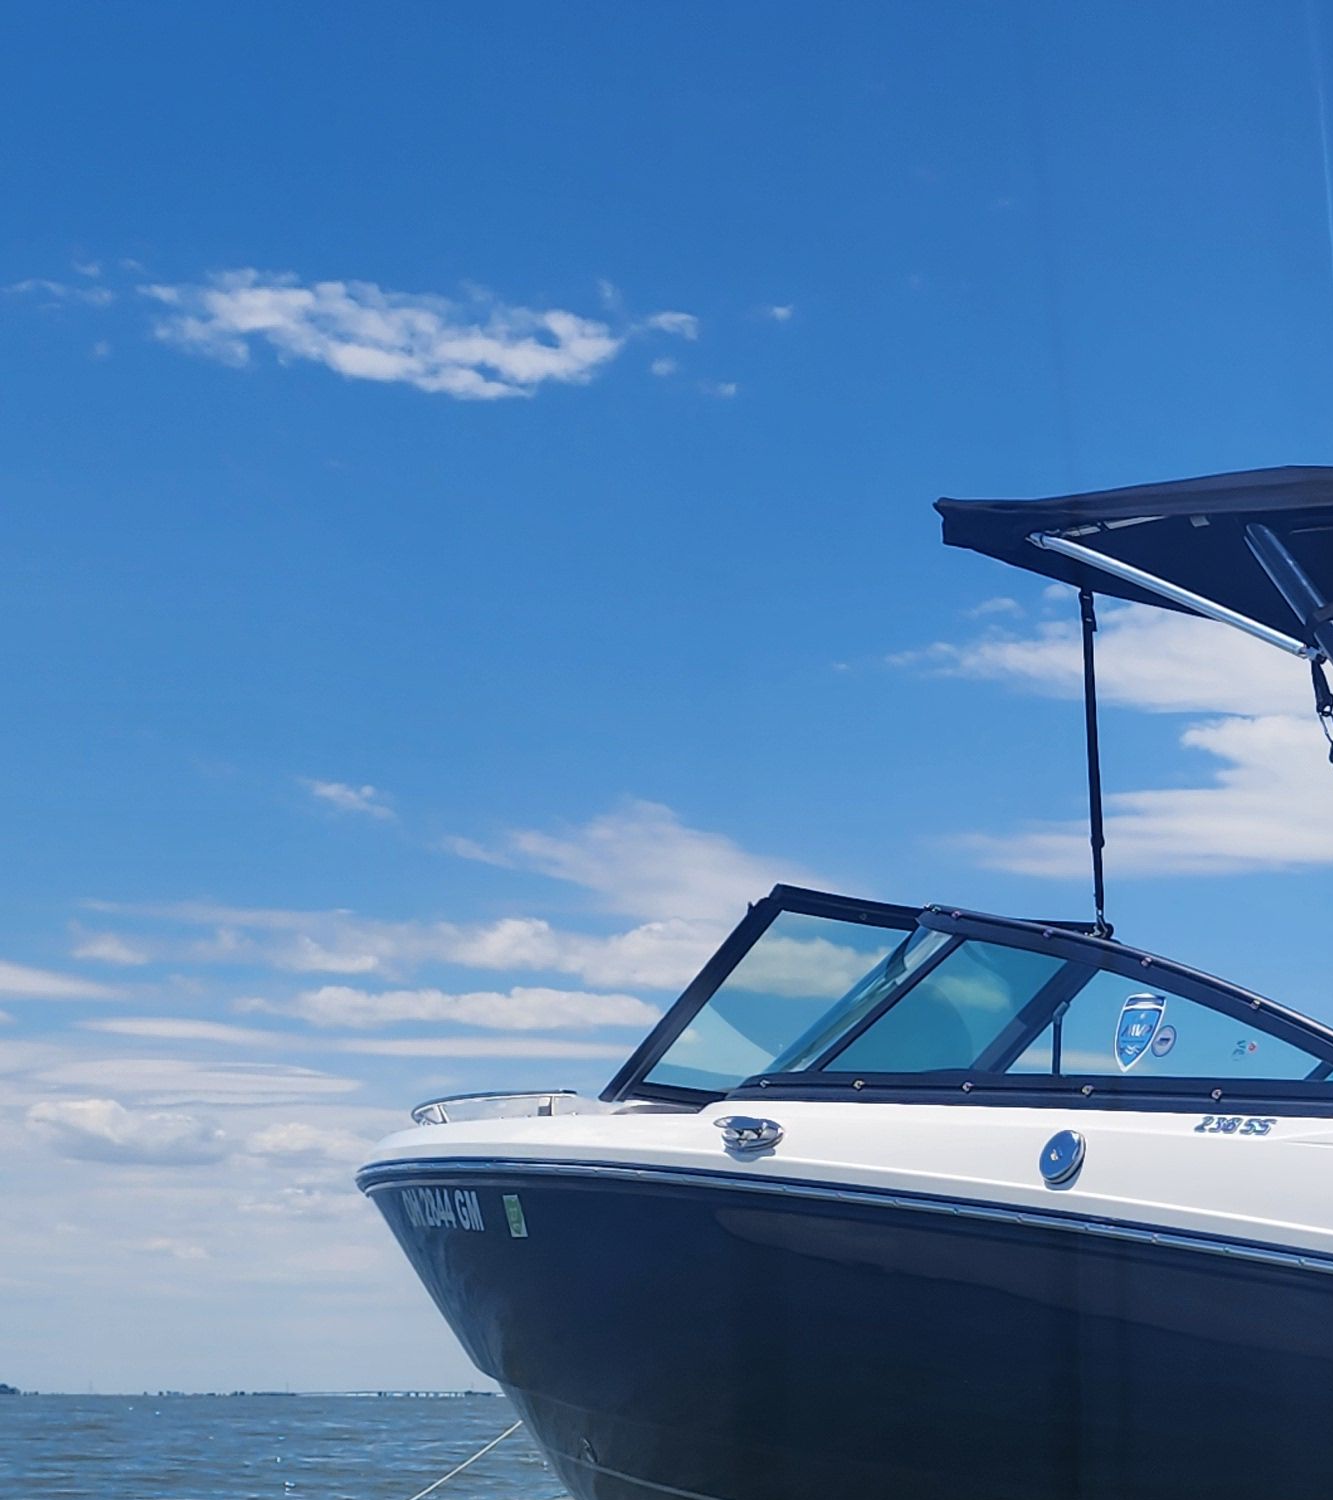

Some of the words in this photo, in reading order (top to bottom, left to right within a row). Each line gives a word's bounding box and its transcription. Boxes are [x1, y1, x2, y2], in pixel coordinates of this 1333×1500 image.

[1194, 1116, 1244, 1134] 238
[1239, 1118, 1277, 1136] SS
[454, 1190, 485, 1232] GM
